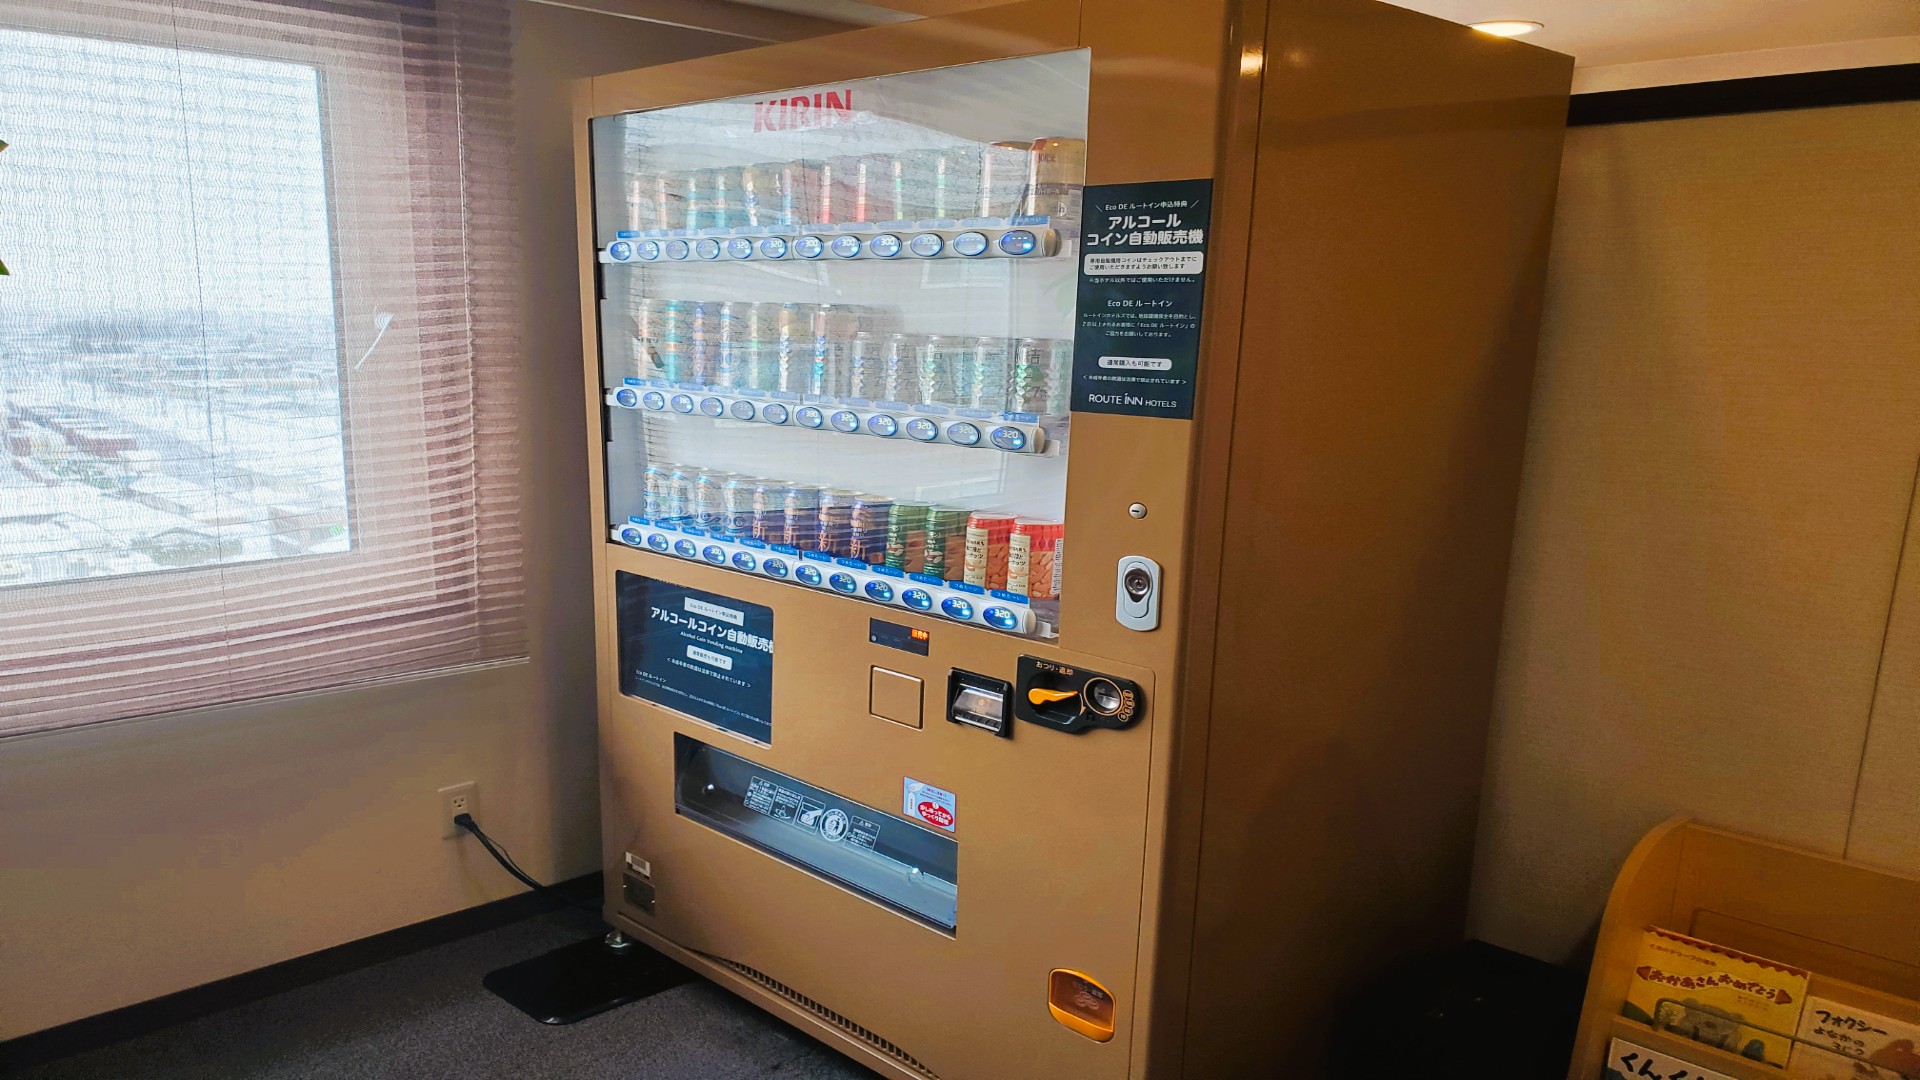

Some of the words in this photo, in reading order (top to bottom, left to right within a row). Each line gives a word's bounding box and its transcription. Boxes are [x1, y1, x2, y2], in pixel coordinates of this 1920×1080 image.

[754, 90, 852, 133] KIRIN
[1129, 200, 1188, 210] ルートイン申込特典
[1108, 213, 1182, 230] アルコール
[880, 237, 895, 246] 300
[921, 236, 937, 245] 300
[1086, 228, 1204, 247] コイン自動販売機
[736, 241, 749, 249] 320
[769, 240, 782, 248] 320
[805, 239, 818, 248] 300
[841, 238, 856, 247] 300
[1135, 300, 1173, 308] ルートイン
[1106, 359, 1163, 368] 通常購入も可能です
[1088, 393, 1123, 405] ROUTE
[1124, 392, 1144, 406] INN
[1145, 399, 1177, 408] HOTELS
[840, 413, 854, 422] 320
[877, 417, 892, 426] 320
[916, 421, 932, 430] 320
[958, 425, 974, 434] 320
[1002, 429, 1018, 439] 320
[752, 518, 768, 541] 新
[682, 541, 693, 549] 300
[818, 530, 839, 554] 新
[711, 547, 722, 555] 300
[850, 537, 870, 560] 新
[740, 554, 751, 562] 320
[772, 560, 784, 568] 320
[805, 567, 817, 576] 320
[839, 575, 852, 583] 320
[875, 583, 888, 591] 320
[912, 591, 927, 600] 320
[952, 599, 967, 609] 320
[994, 608, 1011, 618] 320
[911, 628, 929, 640] 販売中
[696, 635, 707, 643] Coin
[1035, 660, 1074, 676] おつり・返却
[1649, 969, 1776, 1000] おかあさんおめでとう
[1815, 1010, 1888, 1036] フォクシー
